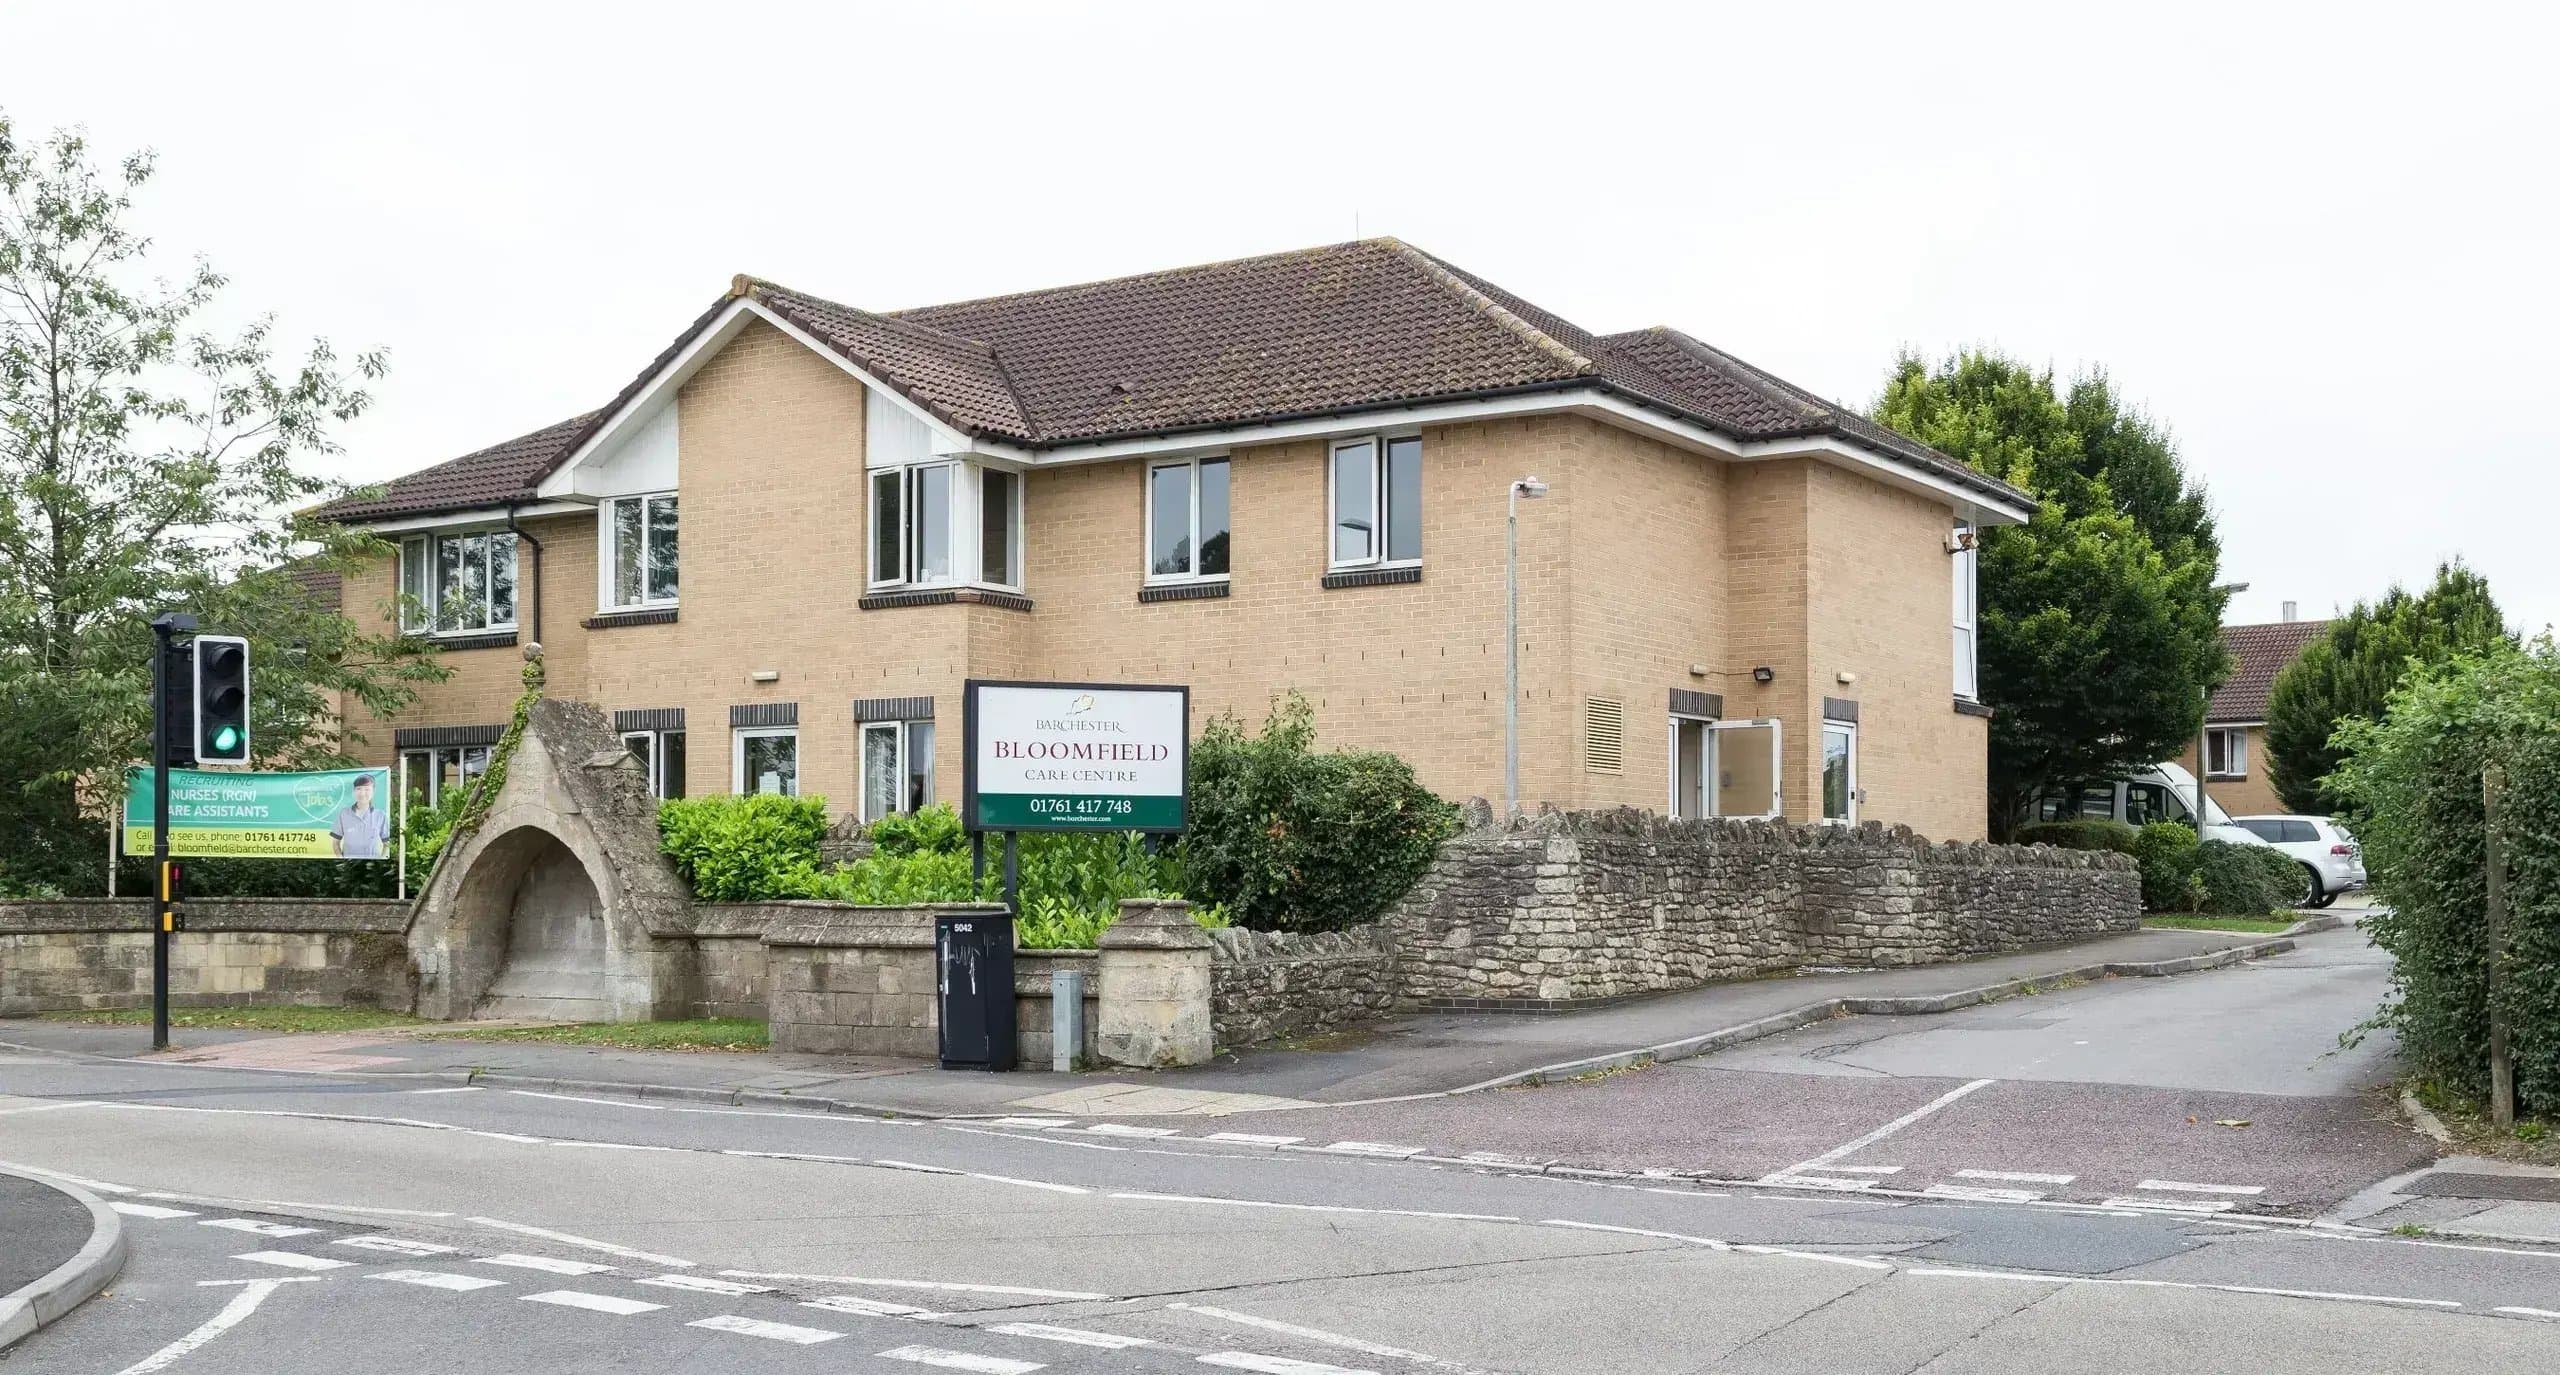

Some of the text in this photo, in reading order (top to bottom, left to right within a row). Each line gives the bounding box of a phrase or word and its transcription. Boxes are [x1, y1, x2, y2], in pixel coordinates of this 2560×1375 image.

[1036, 719, 1128, 734] BARCHESTER
[994, 741, 1168, 762] BLOOMFIELD
[179, 775, 254, 786] RECRUITING
[1025, 769, 1138, 782] CARE CENTRE
[171, 789, 257, 802] NURSES (RGN)
[168, 805, 269, 817] ARE ASSISTANTS
[1030, 799, 1132, 814] 01761 417 748
[177, 832, 193, 841] see
[244, 832, 275, 842] 01761
[278, 833, 316, 843] 417748
[177, 843, 308, 855] bloomfield@barchester.com
[954, 923, 973, 933] 5042
